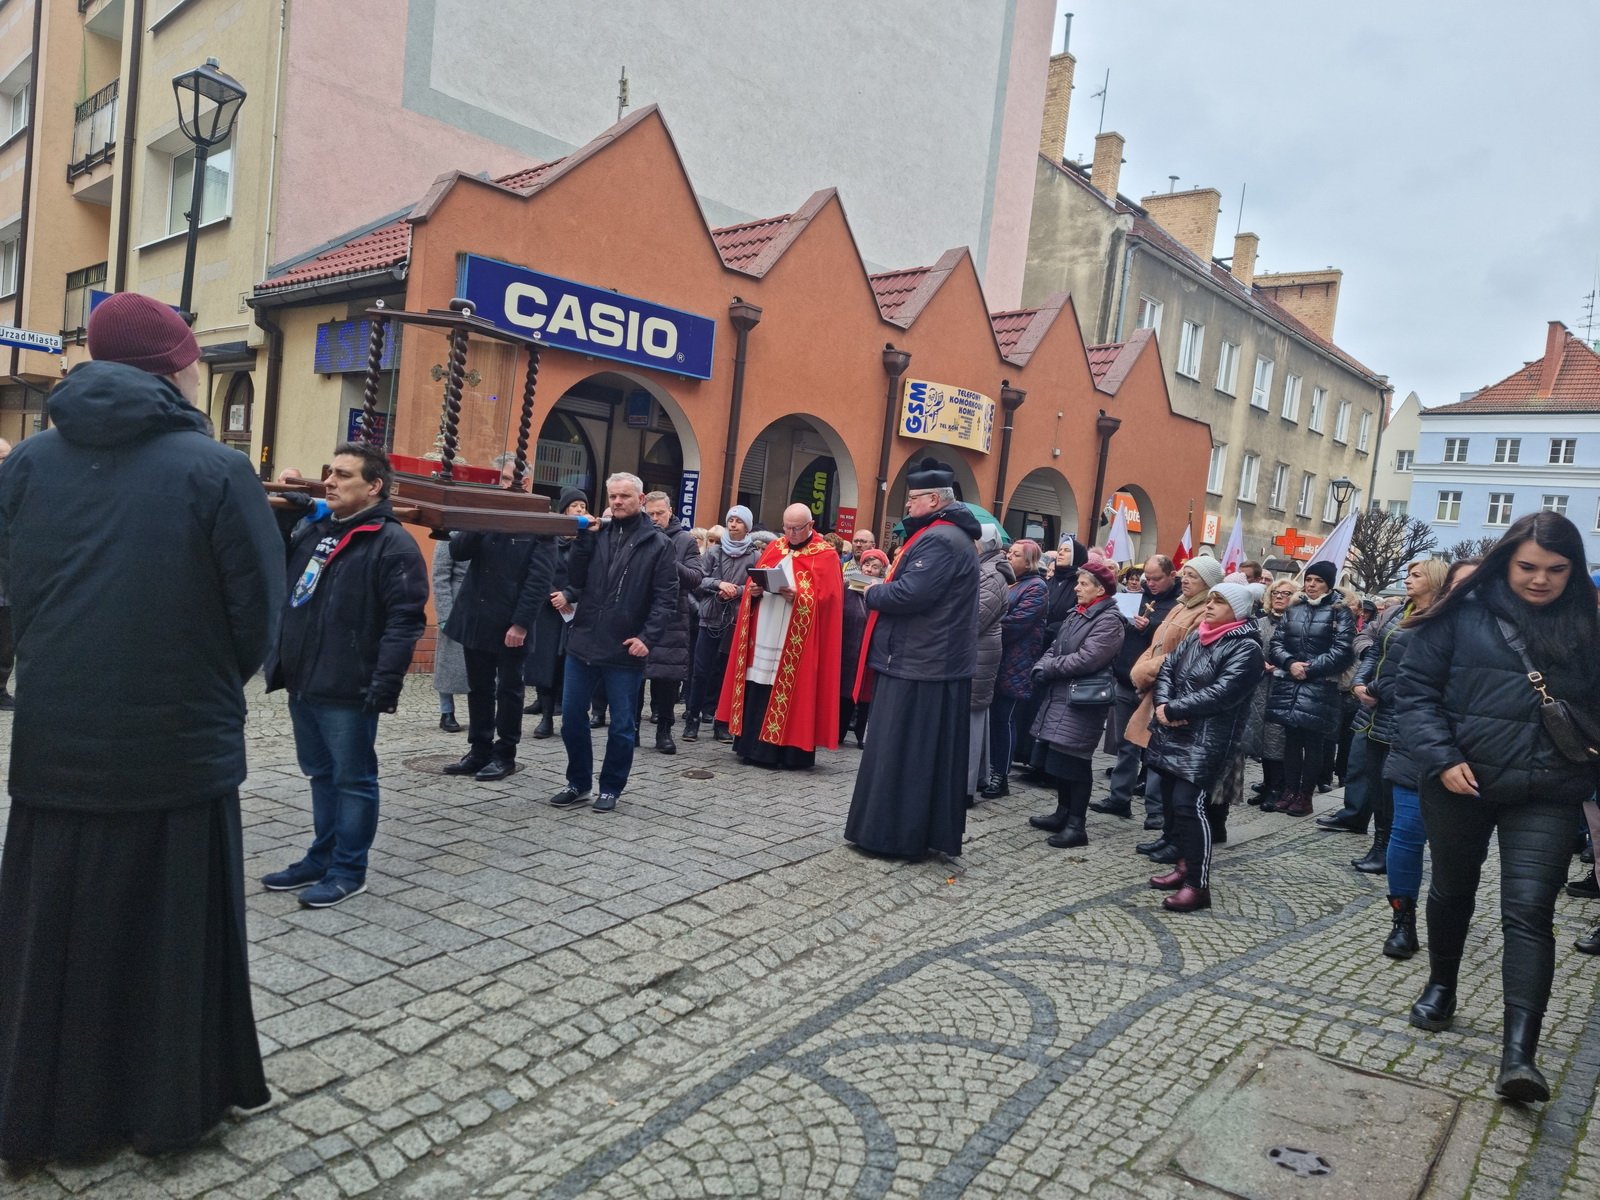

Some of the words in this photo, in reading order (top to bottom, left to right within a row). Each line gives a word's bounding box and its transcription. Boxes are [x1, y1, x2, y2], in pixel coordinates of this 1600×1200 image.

[28, 333, 59, 347] Miasta
[504, 282, 678, 359] CASIO
[905, 383, 928, 434] GSM
